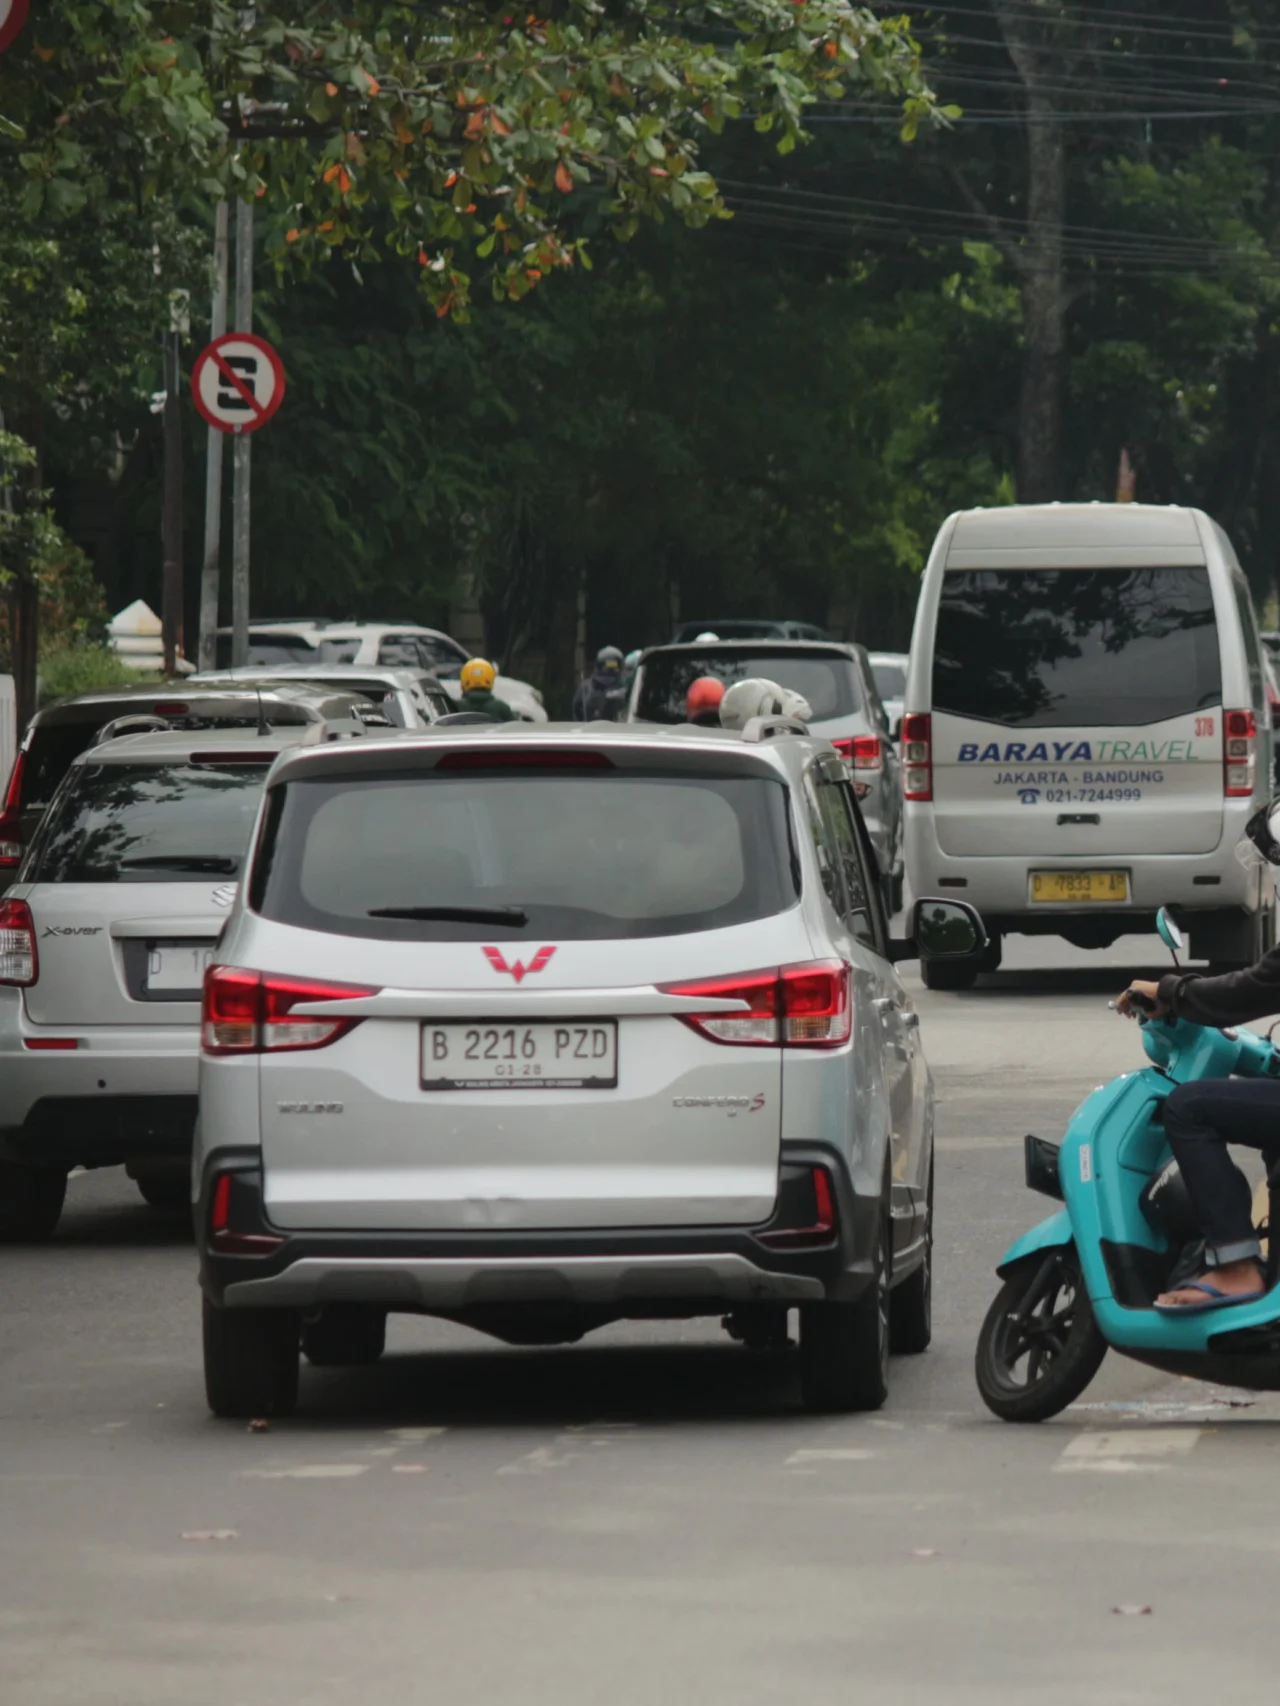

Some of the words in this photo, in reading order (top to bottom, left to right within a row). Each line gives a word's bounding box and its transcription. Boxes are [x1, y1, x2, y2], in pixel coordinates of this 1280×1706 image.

[957, 741, 1093, 762] BARAYA
[1095, 740, 1199, 761] TRAVEL
[994, 771, 1069, 785] JAKARTA
[1082, 770, 1164, 784] BANDUNG
[1045, 788, 1141, 803] 021-7244999
[40, 925, 104, 939] X-over
[432, 1030, 449, 1061] B
[464, 1029, 537, 1060] 2216
[555, 1028, 608, 1059] PZD
